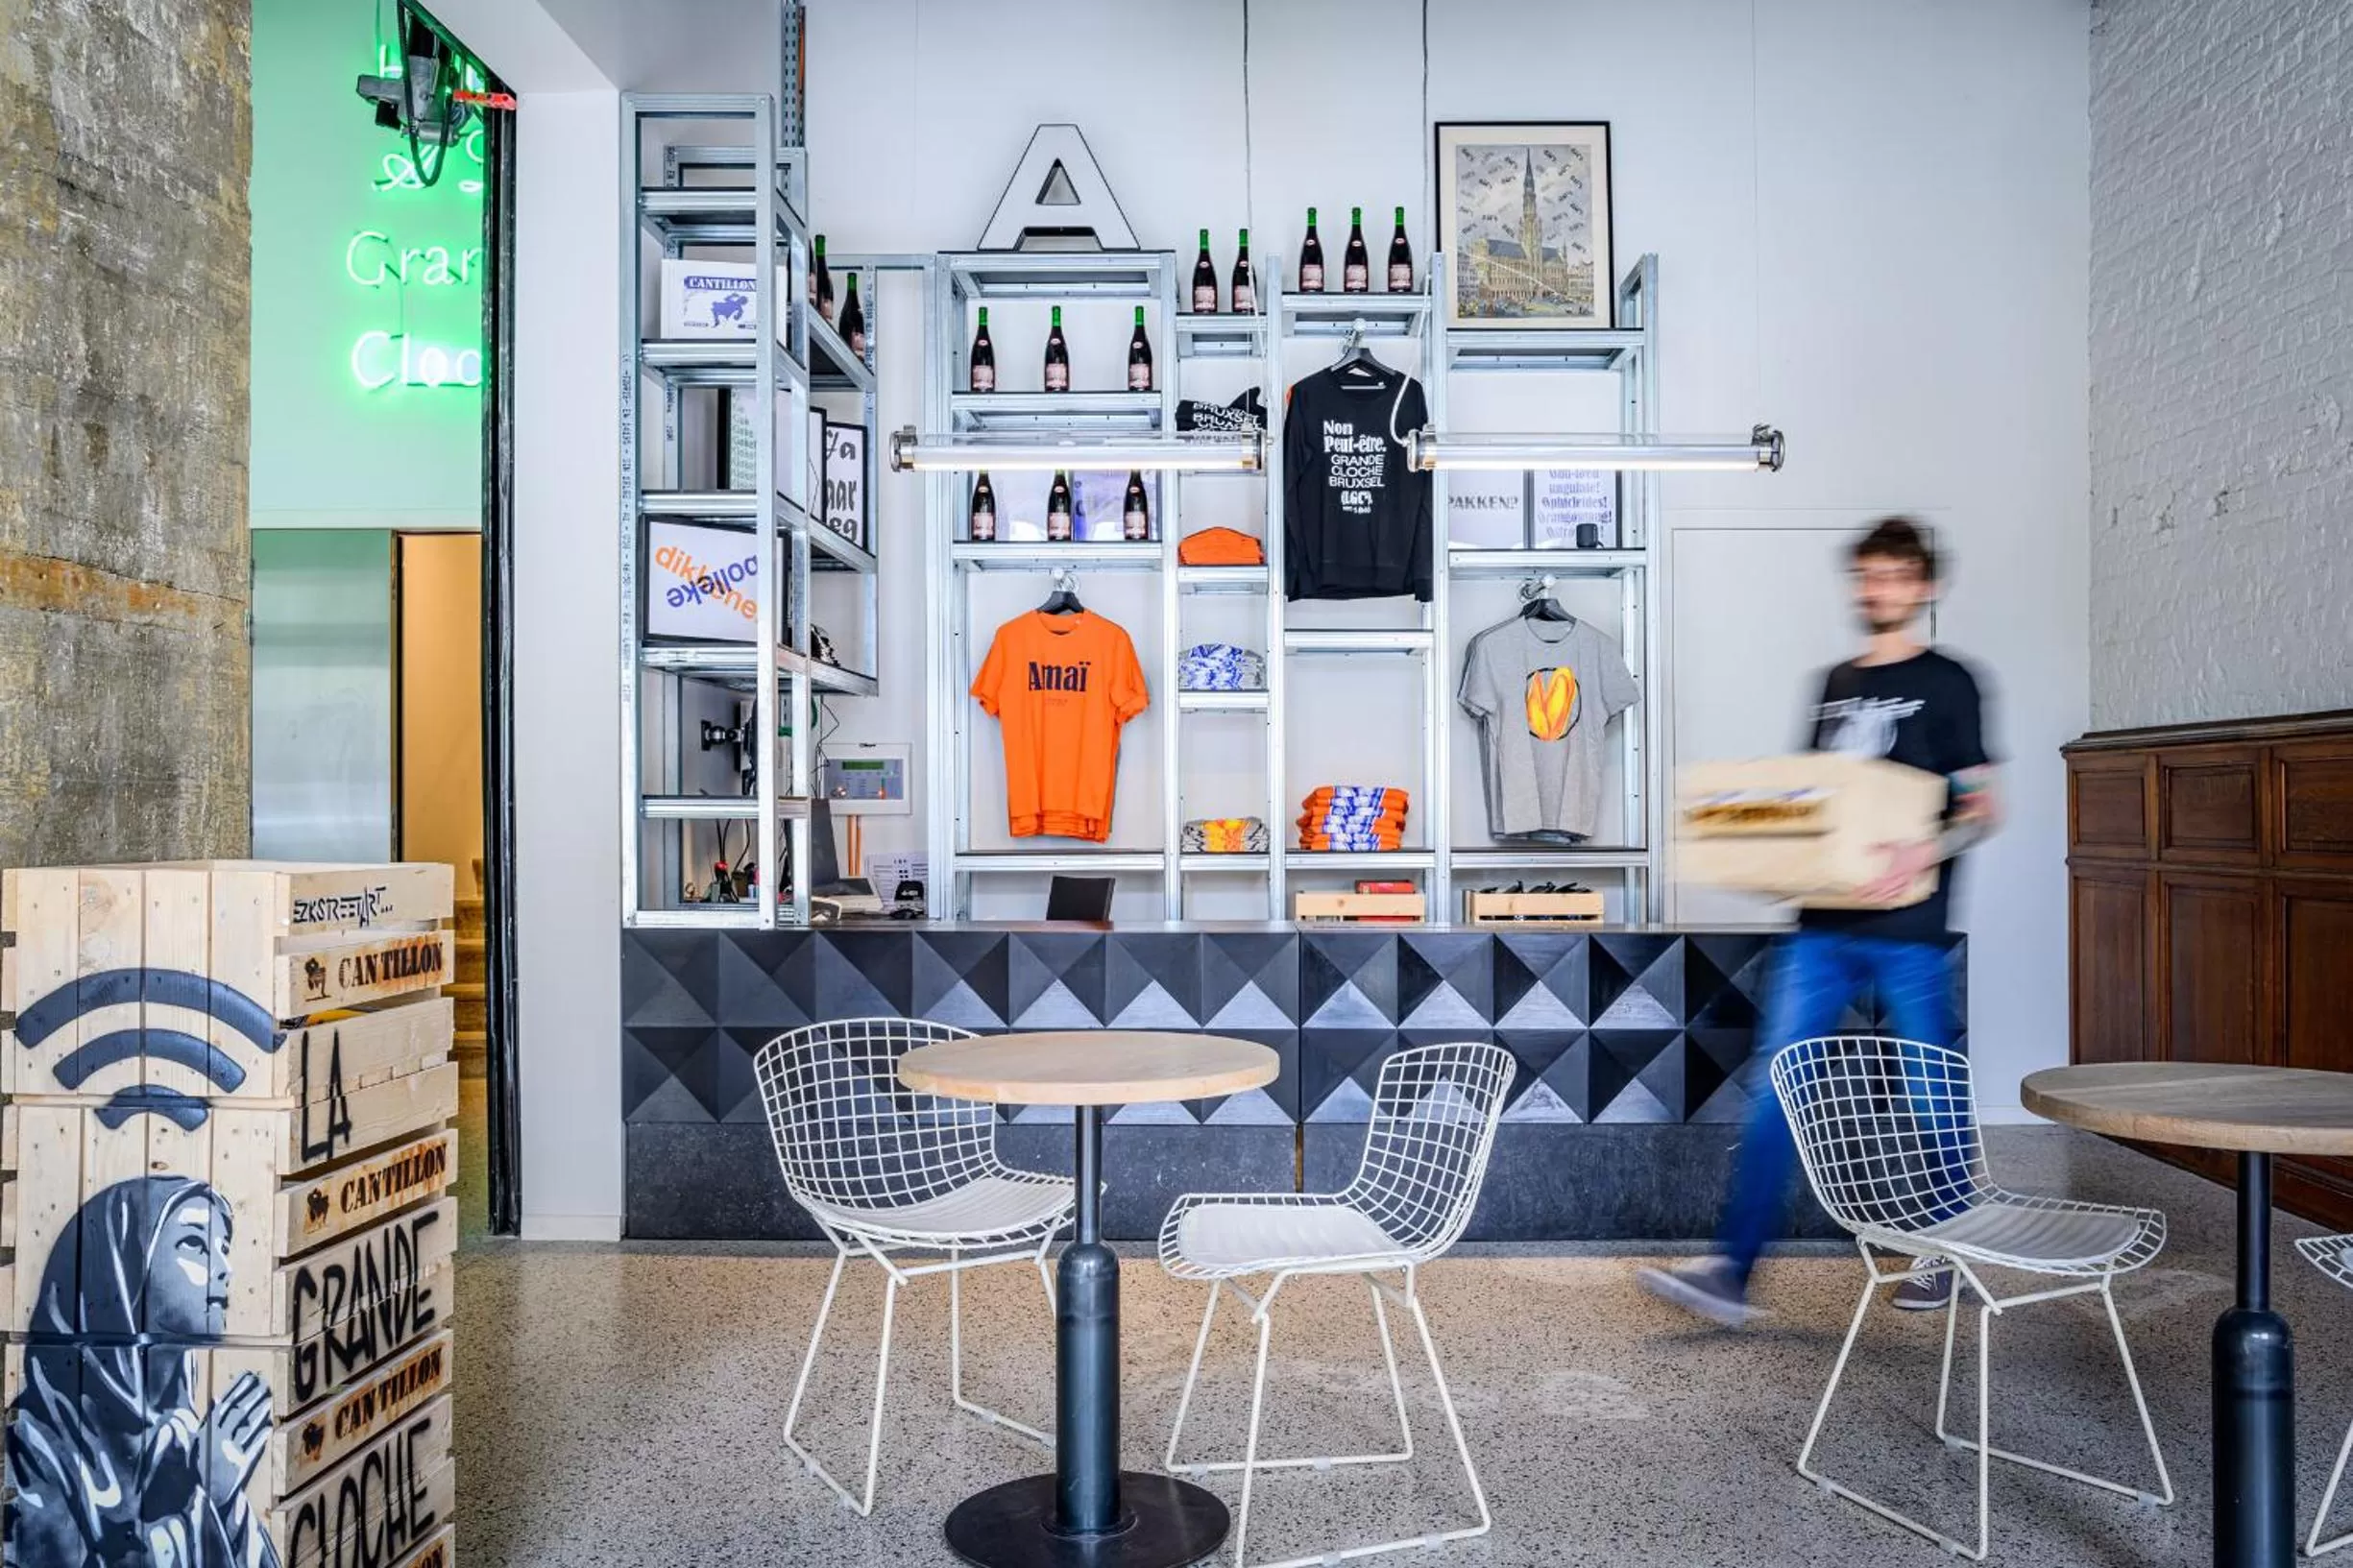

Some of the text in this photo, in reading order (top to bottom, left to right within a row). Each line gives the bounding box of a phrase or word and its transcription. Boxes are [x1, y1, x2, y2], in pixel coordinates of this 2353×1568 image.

[977, 124, 1141, 252] A
[346, 229, 483, 286] Gran
[350, 329, 483, 387] Cloc
[1323, 420, 1352, 435] Non
[1328, 476, 1385, 489] BRUXSEL
[1331, 454, 1384, 467] GRANDE
[1331, 465, 1384, 477] CLOCHE
[1028, 661, 1092, 692] Amaï
[338, 941, 443, 990] CANTILLON
[300, 1026, 352, 1163] LA
[340, 1143, 448, 1215] CANTILLON
[290, 1209, 439, 1403] GRANDE
[334, 1347, 442, 1440] CANTILLON
